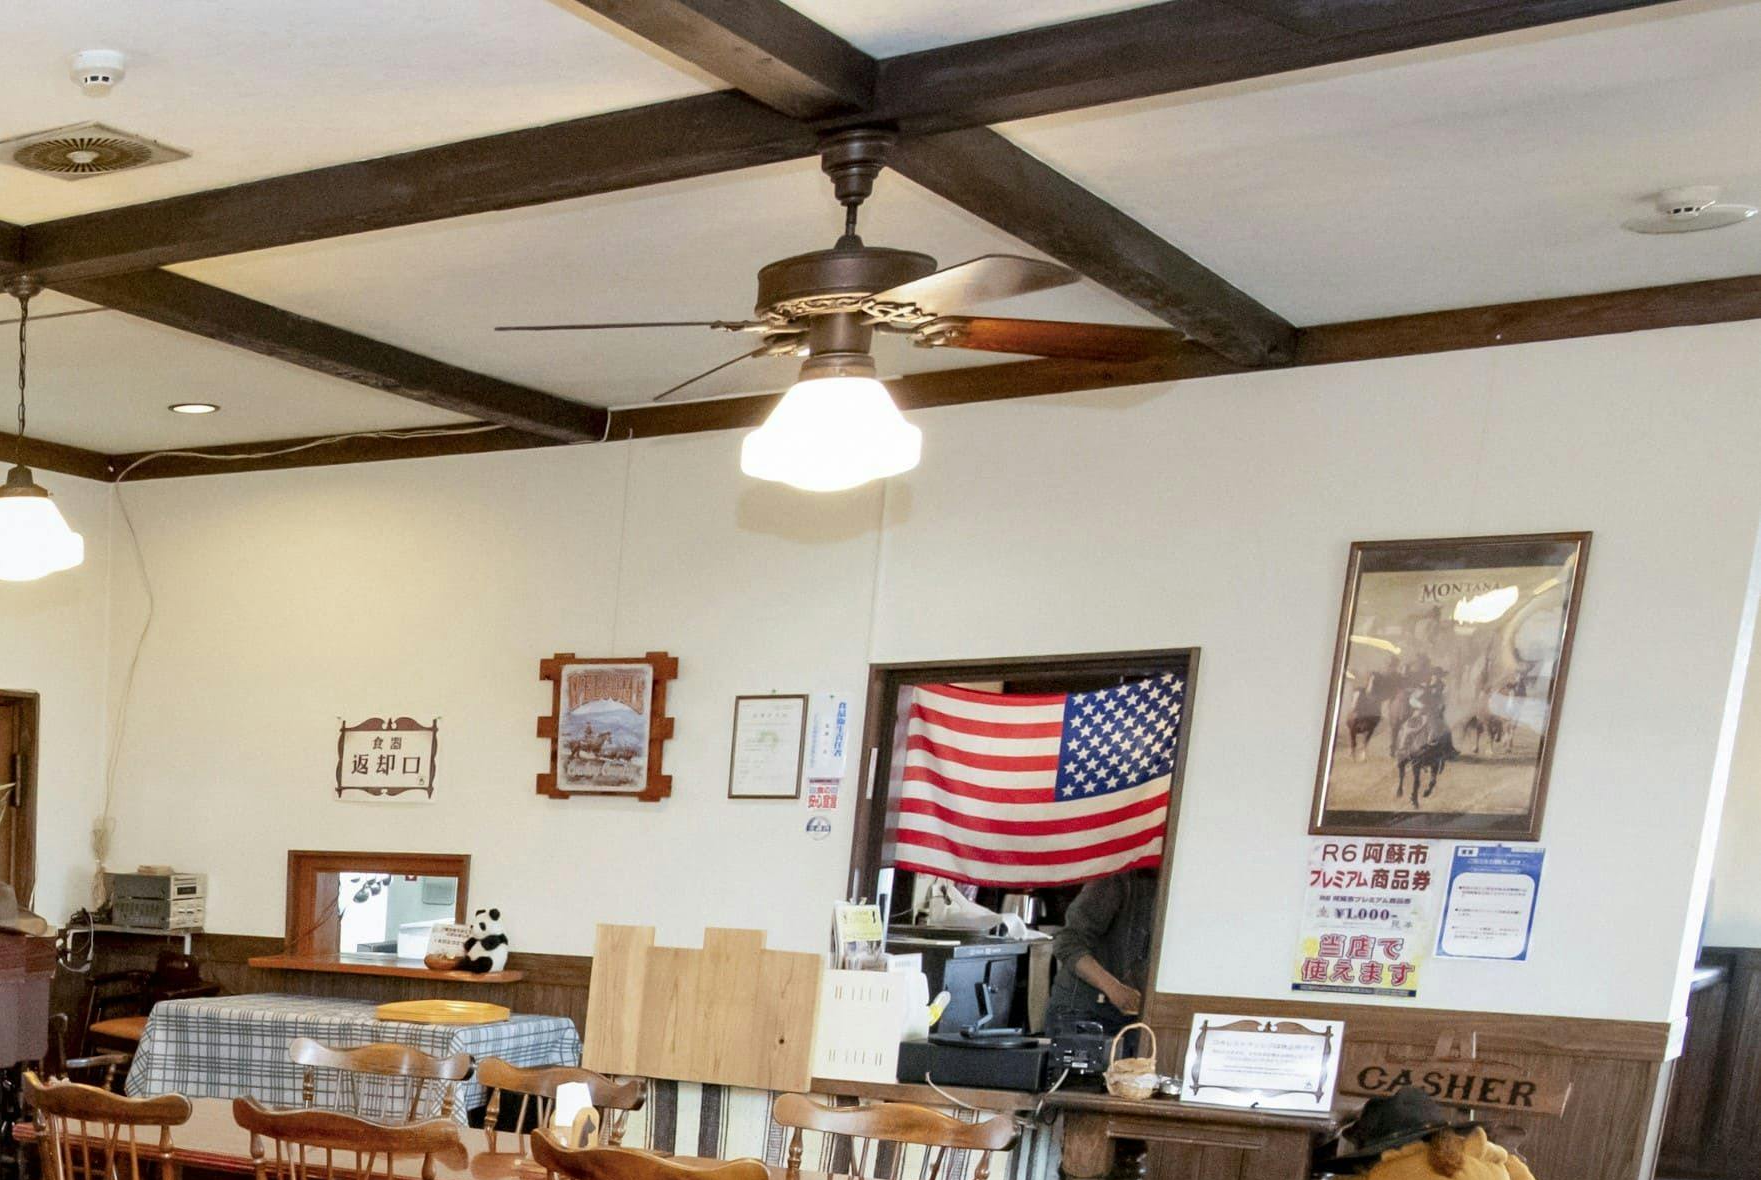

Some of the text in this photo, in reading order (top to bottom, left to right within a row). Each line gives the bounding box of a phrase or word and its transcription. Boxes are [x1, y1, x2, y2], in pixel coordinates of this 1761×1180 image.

[372, 736, 402, 750] 食器
[351, 754, 420, 775] 返却口
[1309, 869, 1432, 891] プレミアム商品券
[1318, 933, 1404, 960] 当店で
[1302, 958, 1415, 986] 使えます
[1357, 1065, 1536, 1108] CASHER
